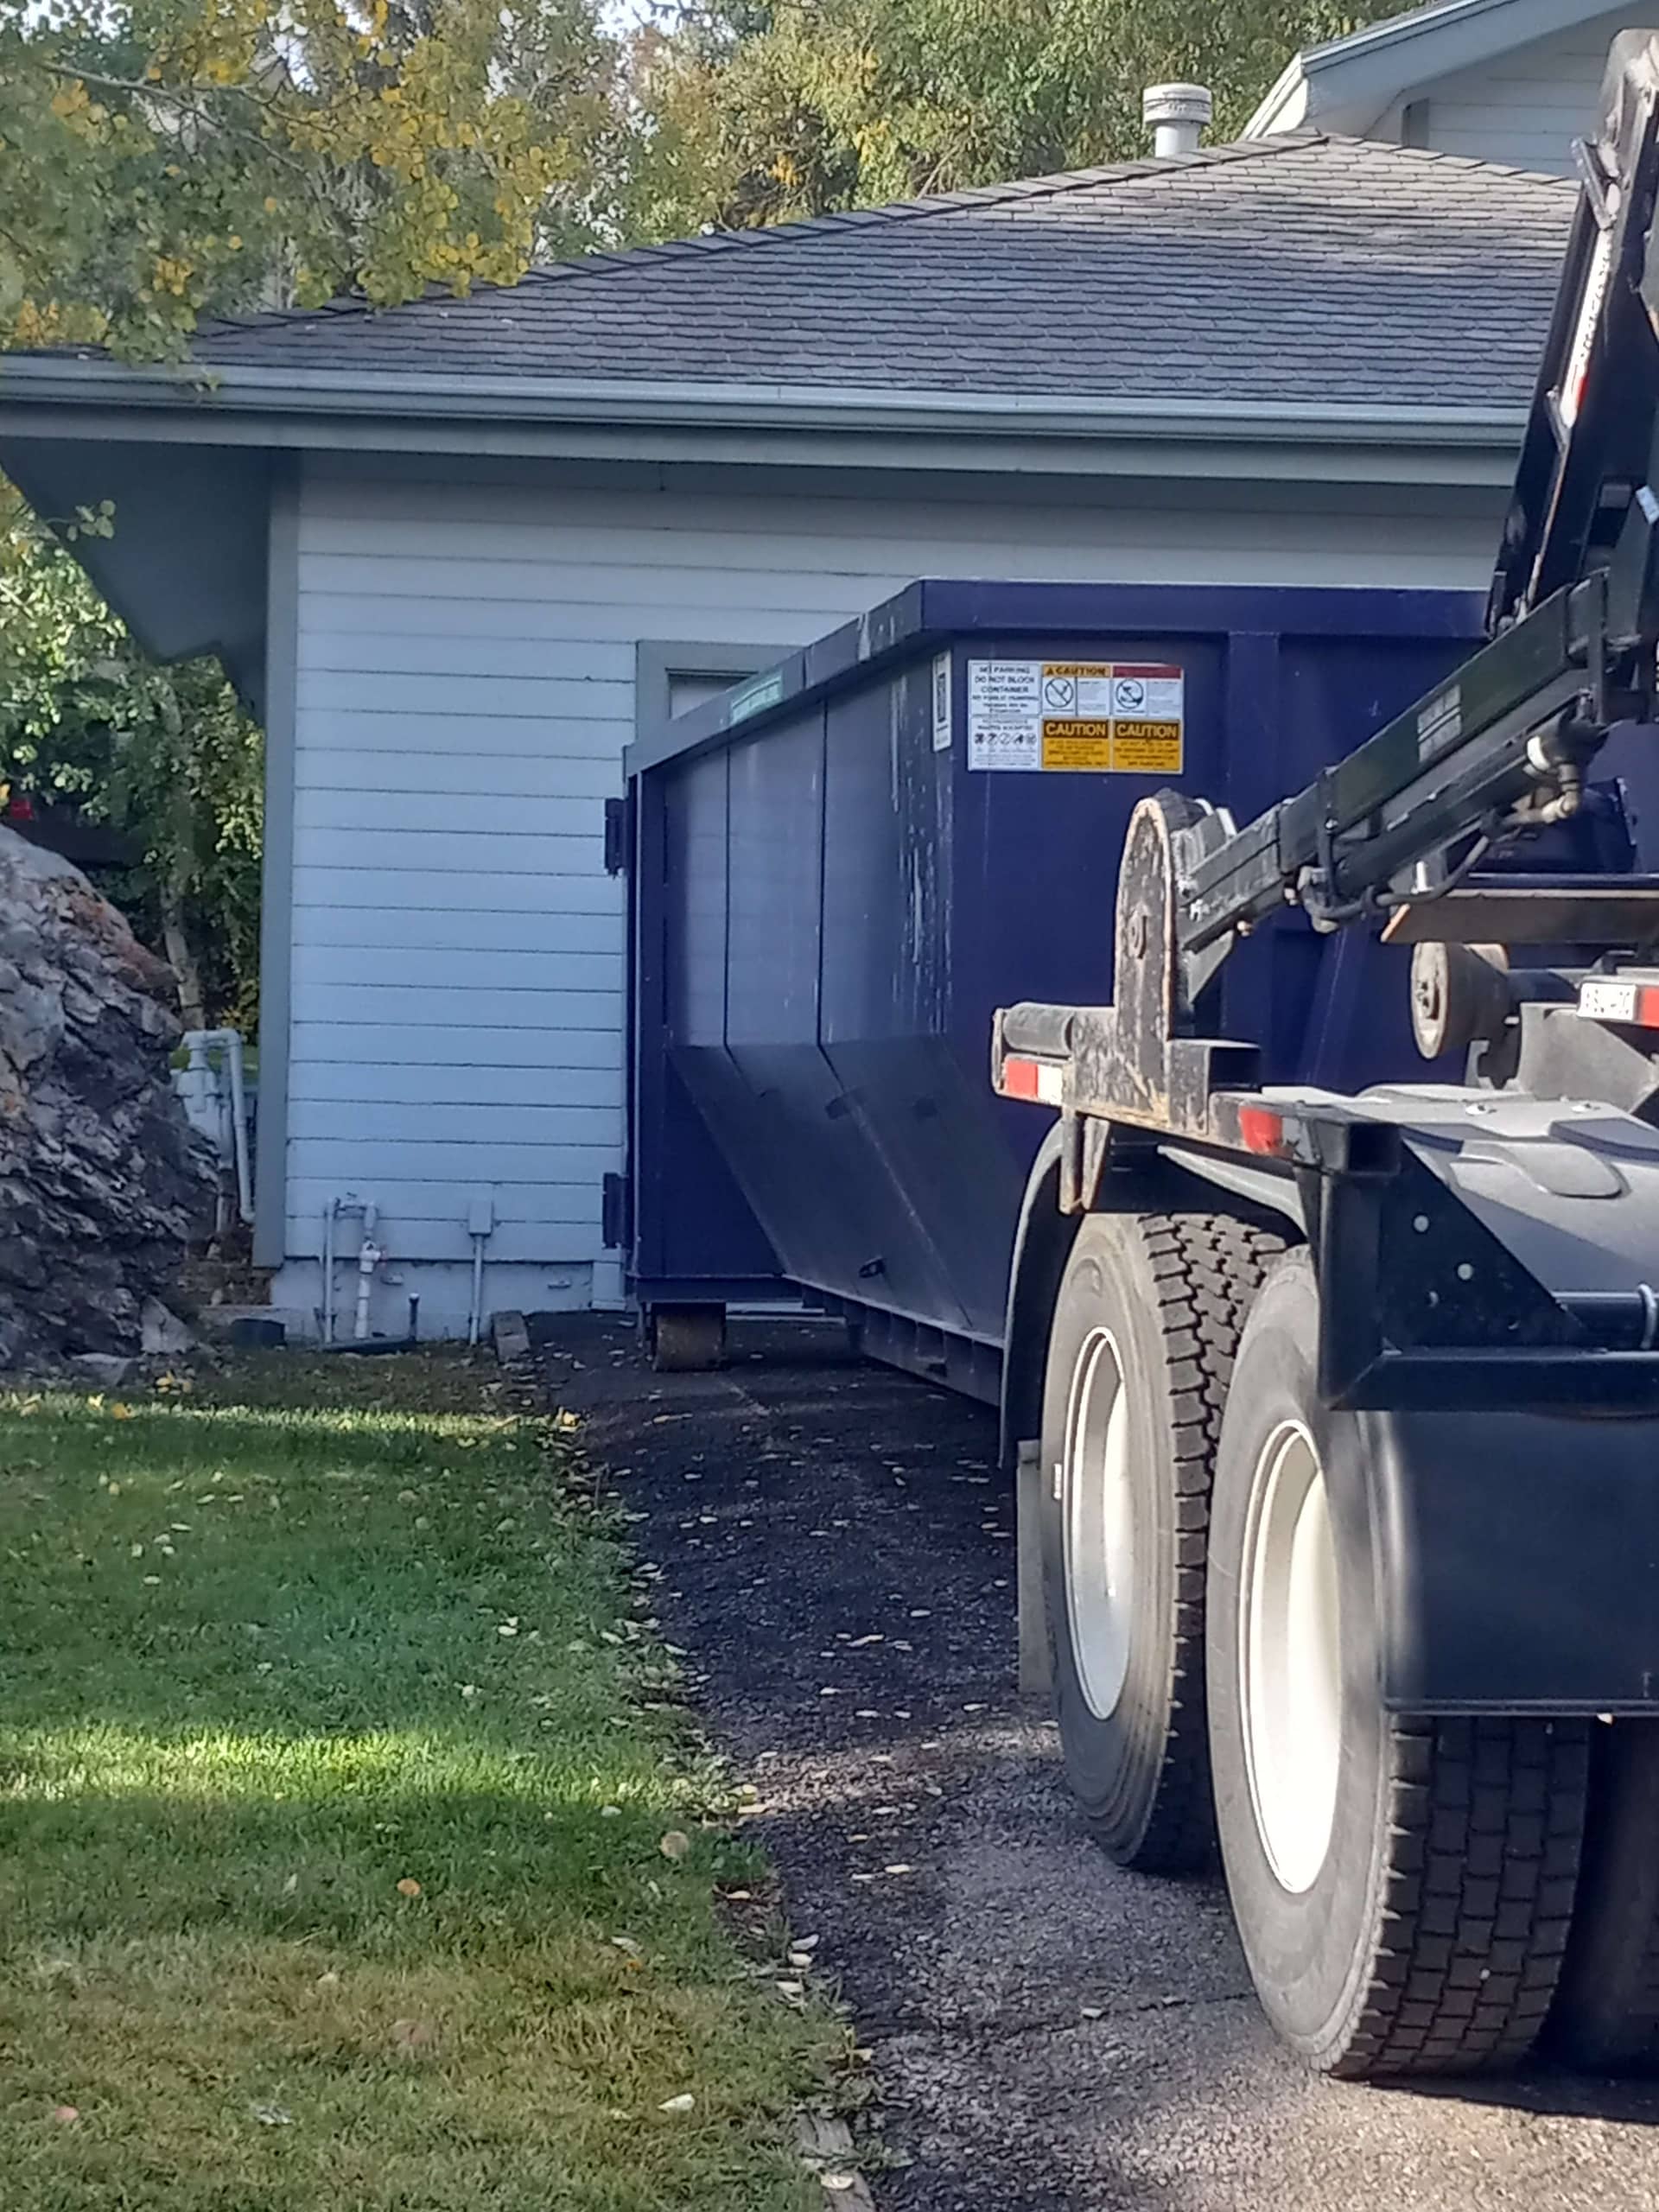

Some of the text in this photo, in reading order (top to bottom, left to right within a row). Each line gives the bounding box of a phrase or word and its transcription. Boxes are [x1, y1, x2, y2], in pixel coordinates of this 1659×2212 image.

[1056, 666, 1106, 677] CAUTION
[1046, 722, 1106, 736] CAUTION
[1116, 723, 1177, 738] CAUTION
